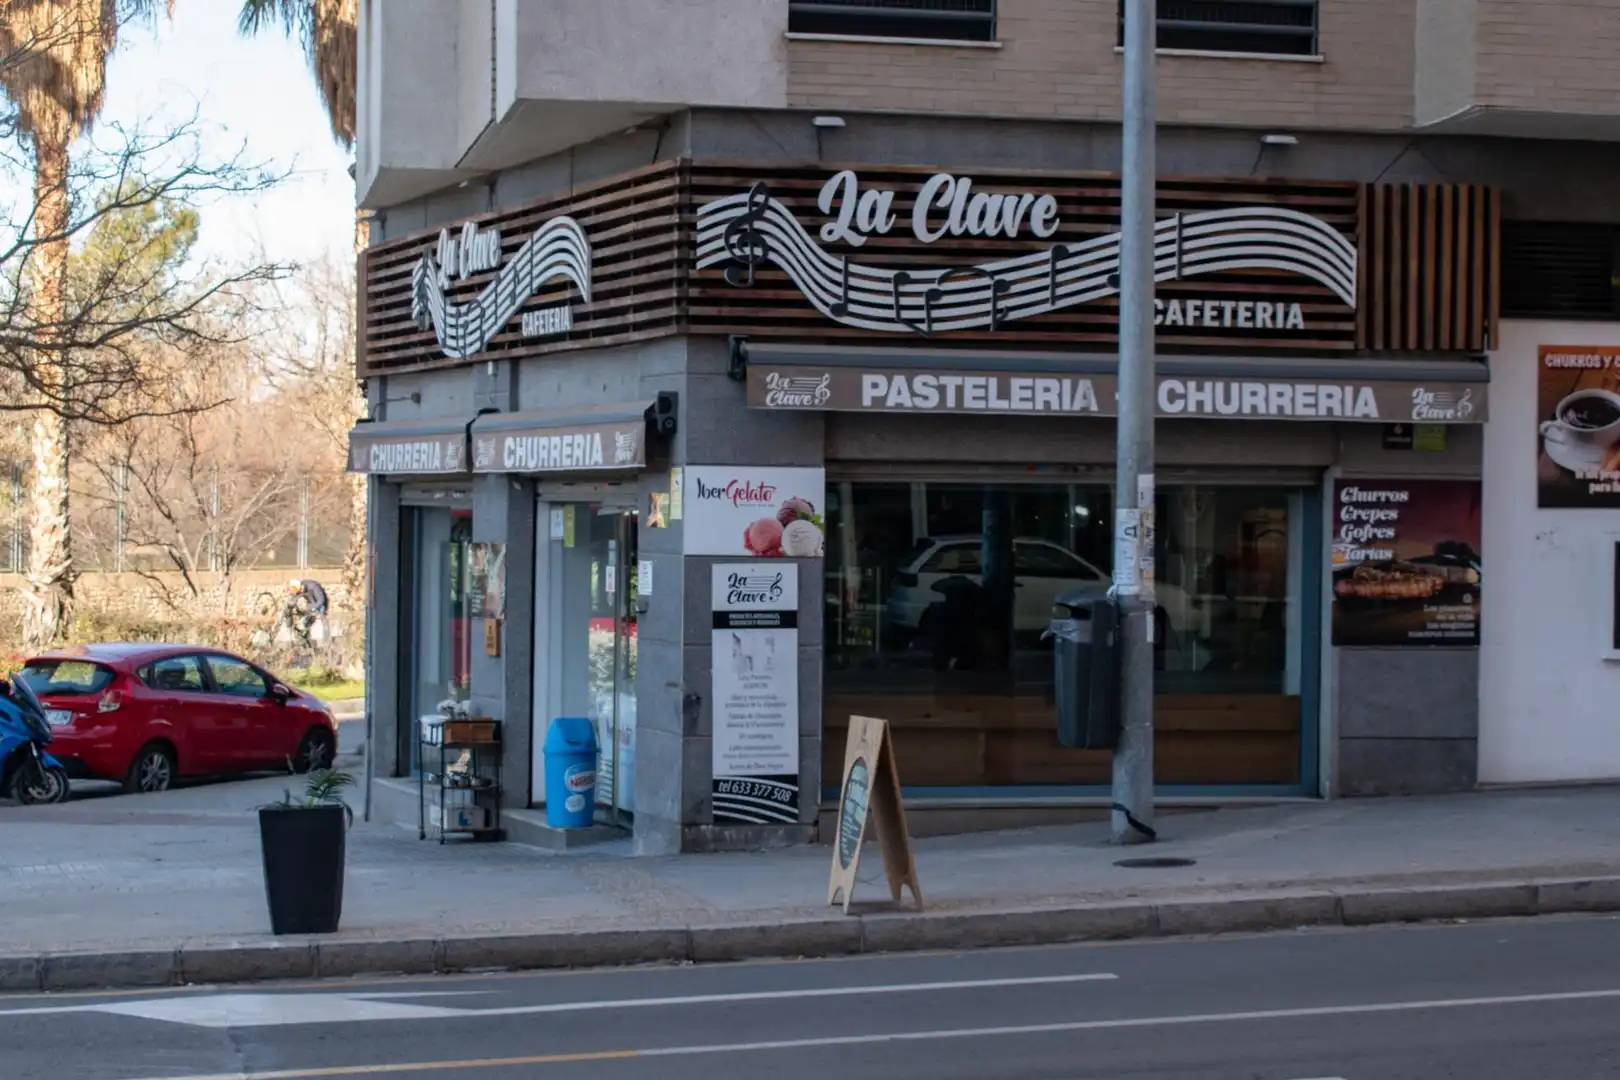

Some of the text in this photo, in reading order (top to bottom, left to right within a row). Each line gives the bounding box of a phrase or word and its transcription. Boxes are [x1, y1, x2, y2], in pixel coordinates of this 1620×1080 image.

[818, 170, 1060, 247] La Clave
[522, 305, 571, 337] CAFETERIA
[1154, 298, 1305, 330] CAFETERIA
[765, 371, 792, 391] La
[765, 389, 813, 407] Clave
[861, 374, 1379, 420] PASTELERIA CHURRERIA
[370, 441, 441, 471] CHURRERIA
[503, 432, 604, 469] CHURRERIA
[1340, 486, 1410, 503] Churros
[1340, 505, 1399, 524] Crepes
[1340, 523, 1396, 542] Gofres
[727, 572, 748, 589] La
[727, 589, 767, 605] Clave
[718, 780, 792, 802] tel 633 377 508
